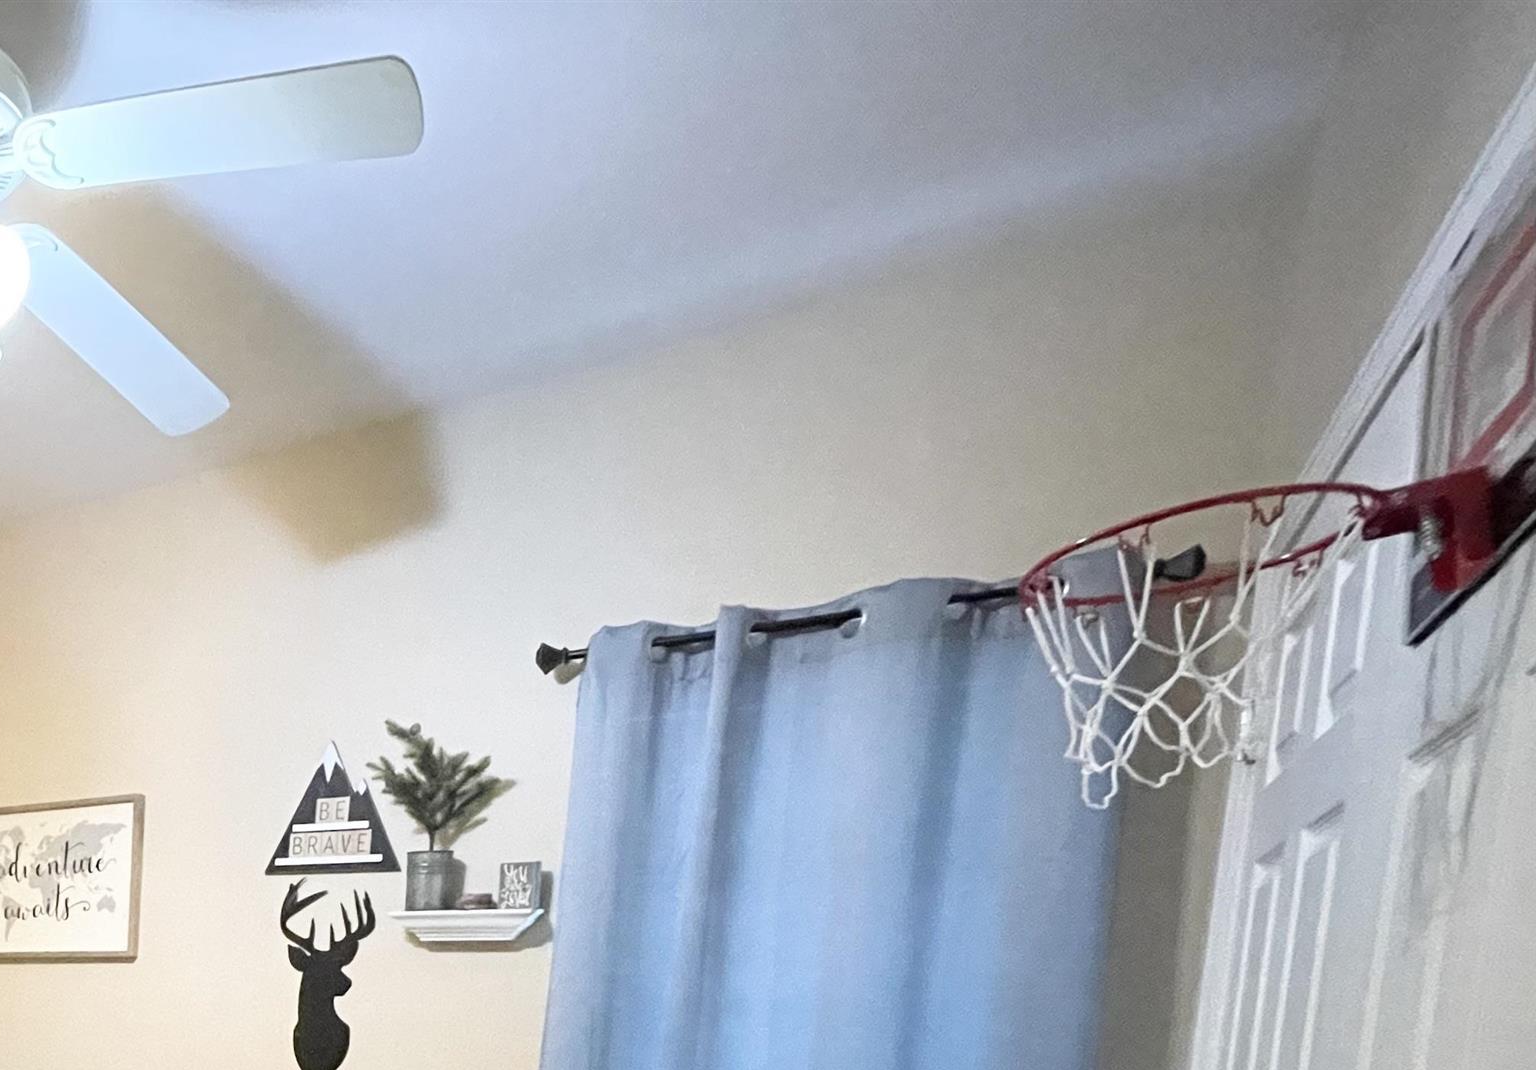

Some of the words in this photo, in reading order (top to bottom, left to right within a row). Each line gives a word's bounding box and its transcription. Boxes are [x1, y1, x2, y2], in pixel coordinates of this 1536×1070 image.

[319, 800, 346, 821] BE
[292, 832, 368, 856] BRAVE
[4, 883, 91, 922] awaits
